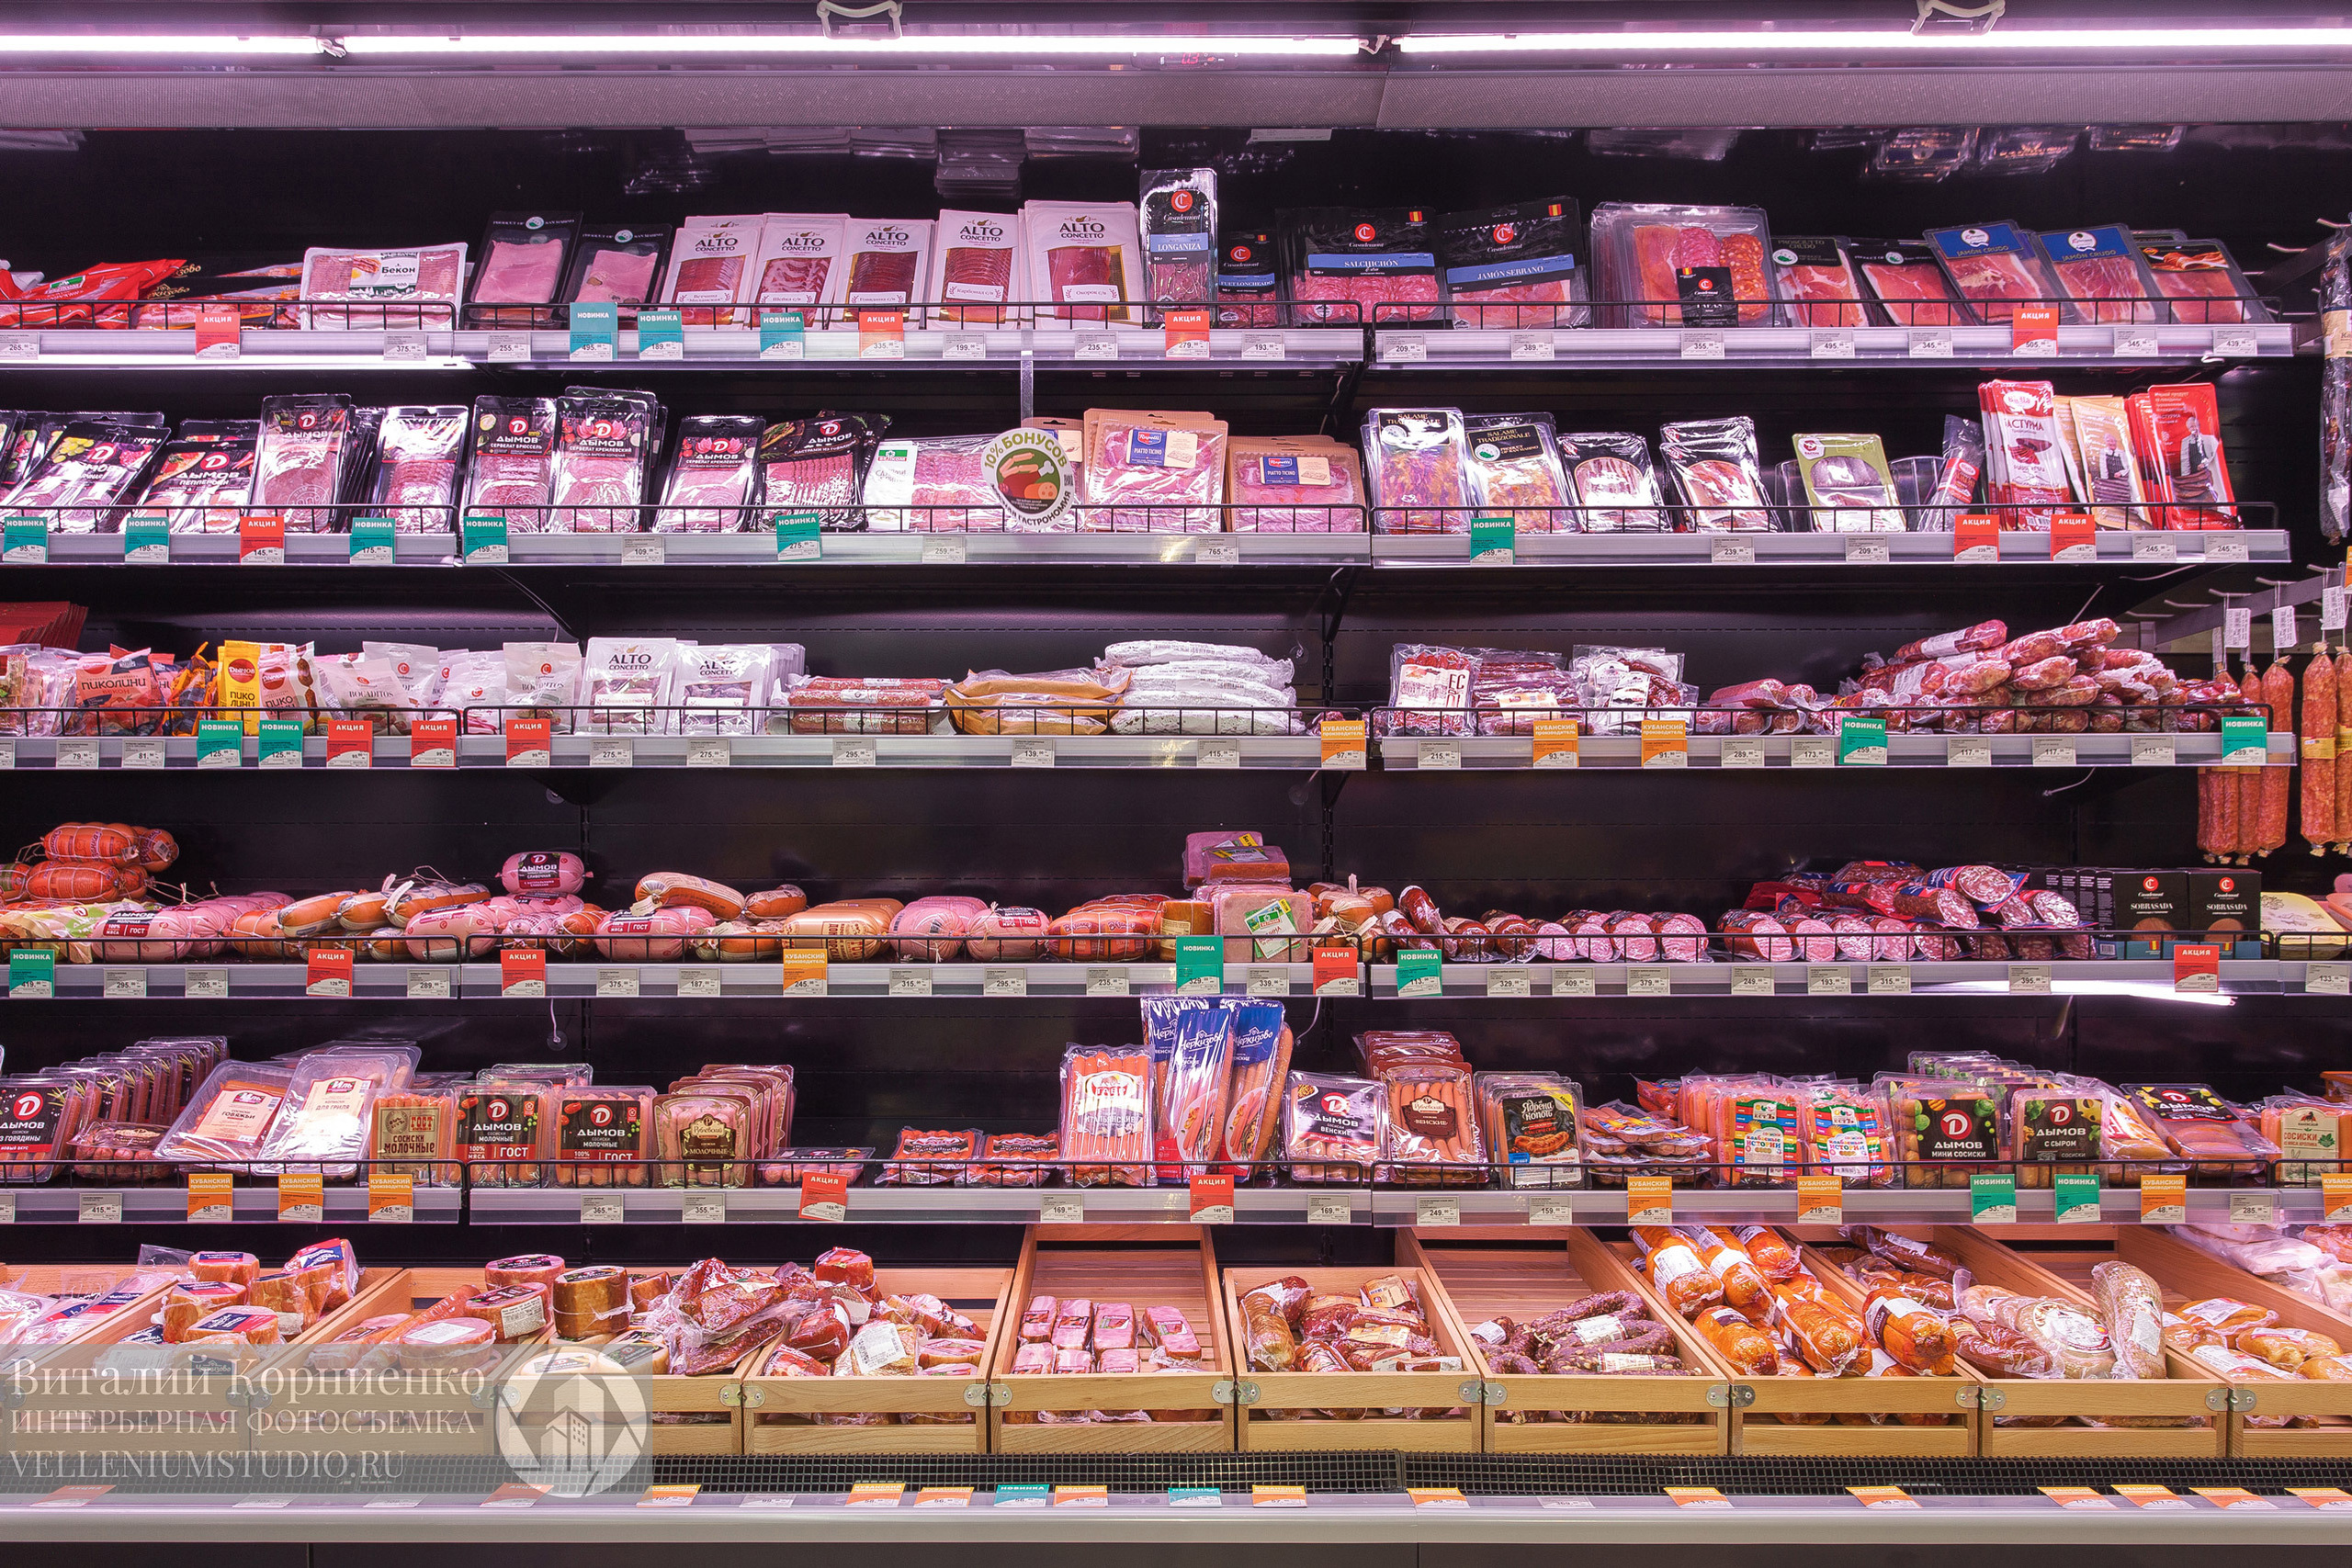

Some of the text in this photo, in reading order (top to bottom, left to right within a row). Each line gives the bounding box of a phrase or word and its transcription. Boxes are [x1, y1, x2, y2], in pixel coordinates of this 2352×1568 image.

[960, 226, 1002, 235] ALTO
[1059, 223, 1104, 232] ALTO
[865, 231, 908, 241] ALTO
[695, 237, 737, 246] ALTO
[782, 237, 824, 246] ALTO
[1981, 245, 2008, 254] CRUDO
[2088, 250, 2116, 259] CRUDO
[1344, 259, 1399, 267] SALCHICHÓN
[1477, 265, 1544, 280] JAMÓN SERRANO
[763, 315, 800, 323] НОВИНКА
[580, 437, 623, 446] ДЫМОВ
[808, 434, 851, 444] ДЫМОВ
[1476, 433, 1531, 443] TRADIZIONALE
[984, 434, 1067, 468] 10% БОНУСОВ
[1017, 491, 1071, 525] ГАСТРОНОМИЯ
[248, 520, 277, 528] АКЦИЯ
[779, 517, 816, 525] НОВИНКА
[609, 653, 650, 664] ALTO
[82, 678, 146, 689] ПИКОЛИНИ
[230, 699, 255, 707] ЛИНИ
[266, 694, 293, 705] ПИКО
[262, 723, 300, 731] НОВИНКА
[1845, 722, 1883, 730] НОВИНКА
[13, 953, 50, 961] НОВИНКА
[1401, 953, 1438, 961] НОВИНКА
[1236, 1031, 1272, 1046] Черкизово
[332, 1081, 354, 1089] Иль
[2158, 1103, 2216, 1111] ДЫМОВ
[222, 1111, 255, 1119] ГОВЯЖЬИ
[412, 1116, 434, 1126] ГОСТ
[1314, 1116, 1358, 1127] ДЫМОВ
[1320, 1127, 1351, 1136] ВЕНСКИЕ
[393, 1134, 424, 1143] СОСИСКИ
[2284, 1132, 2317, 1141] СОСИСКИ
[384, 1142, 435, 1154] МОЛОЧНЫЕ
[500, 1148, 527, 1157] ГОСТ
